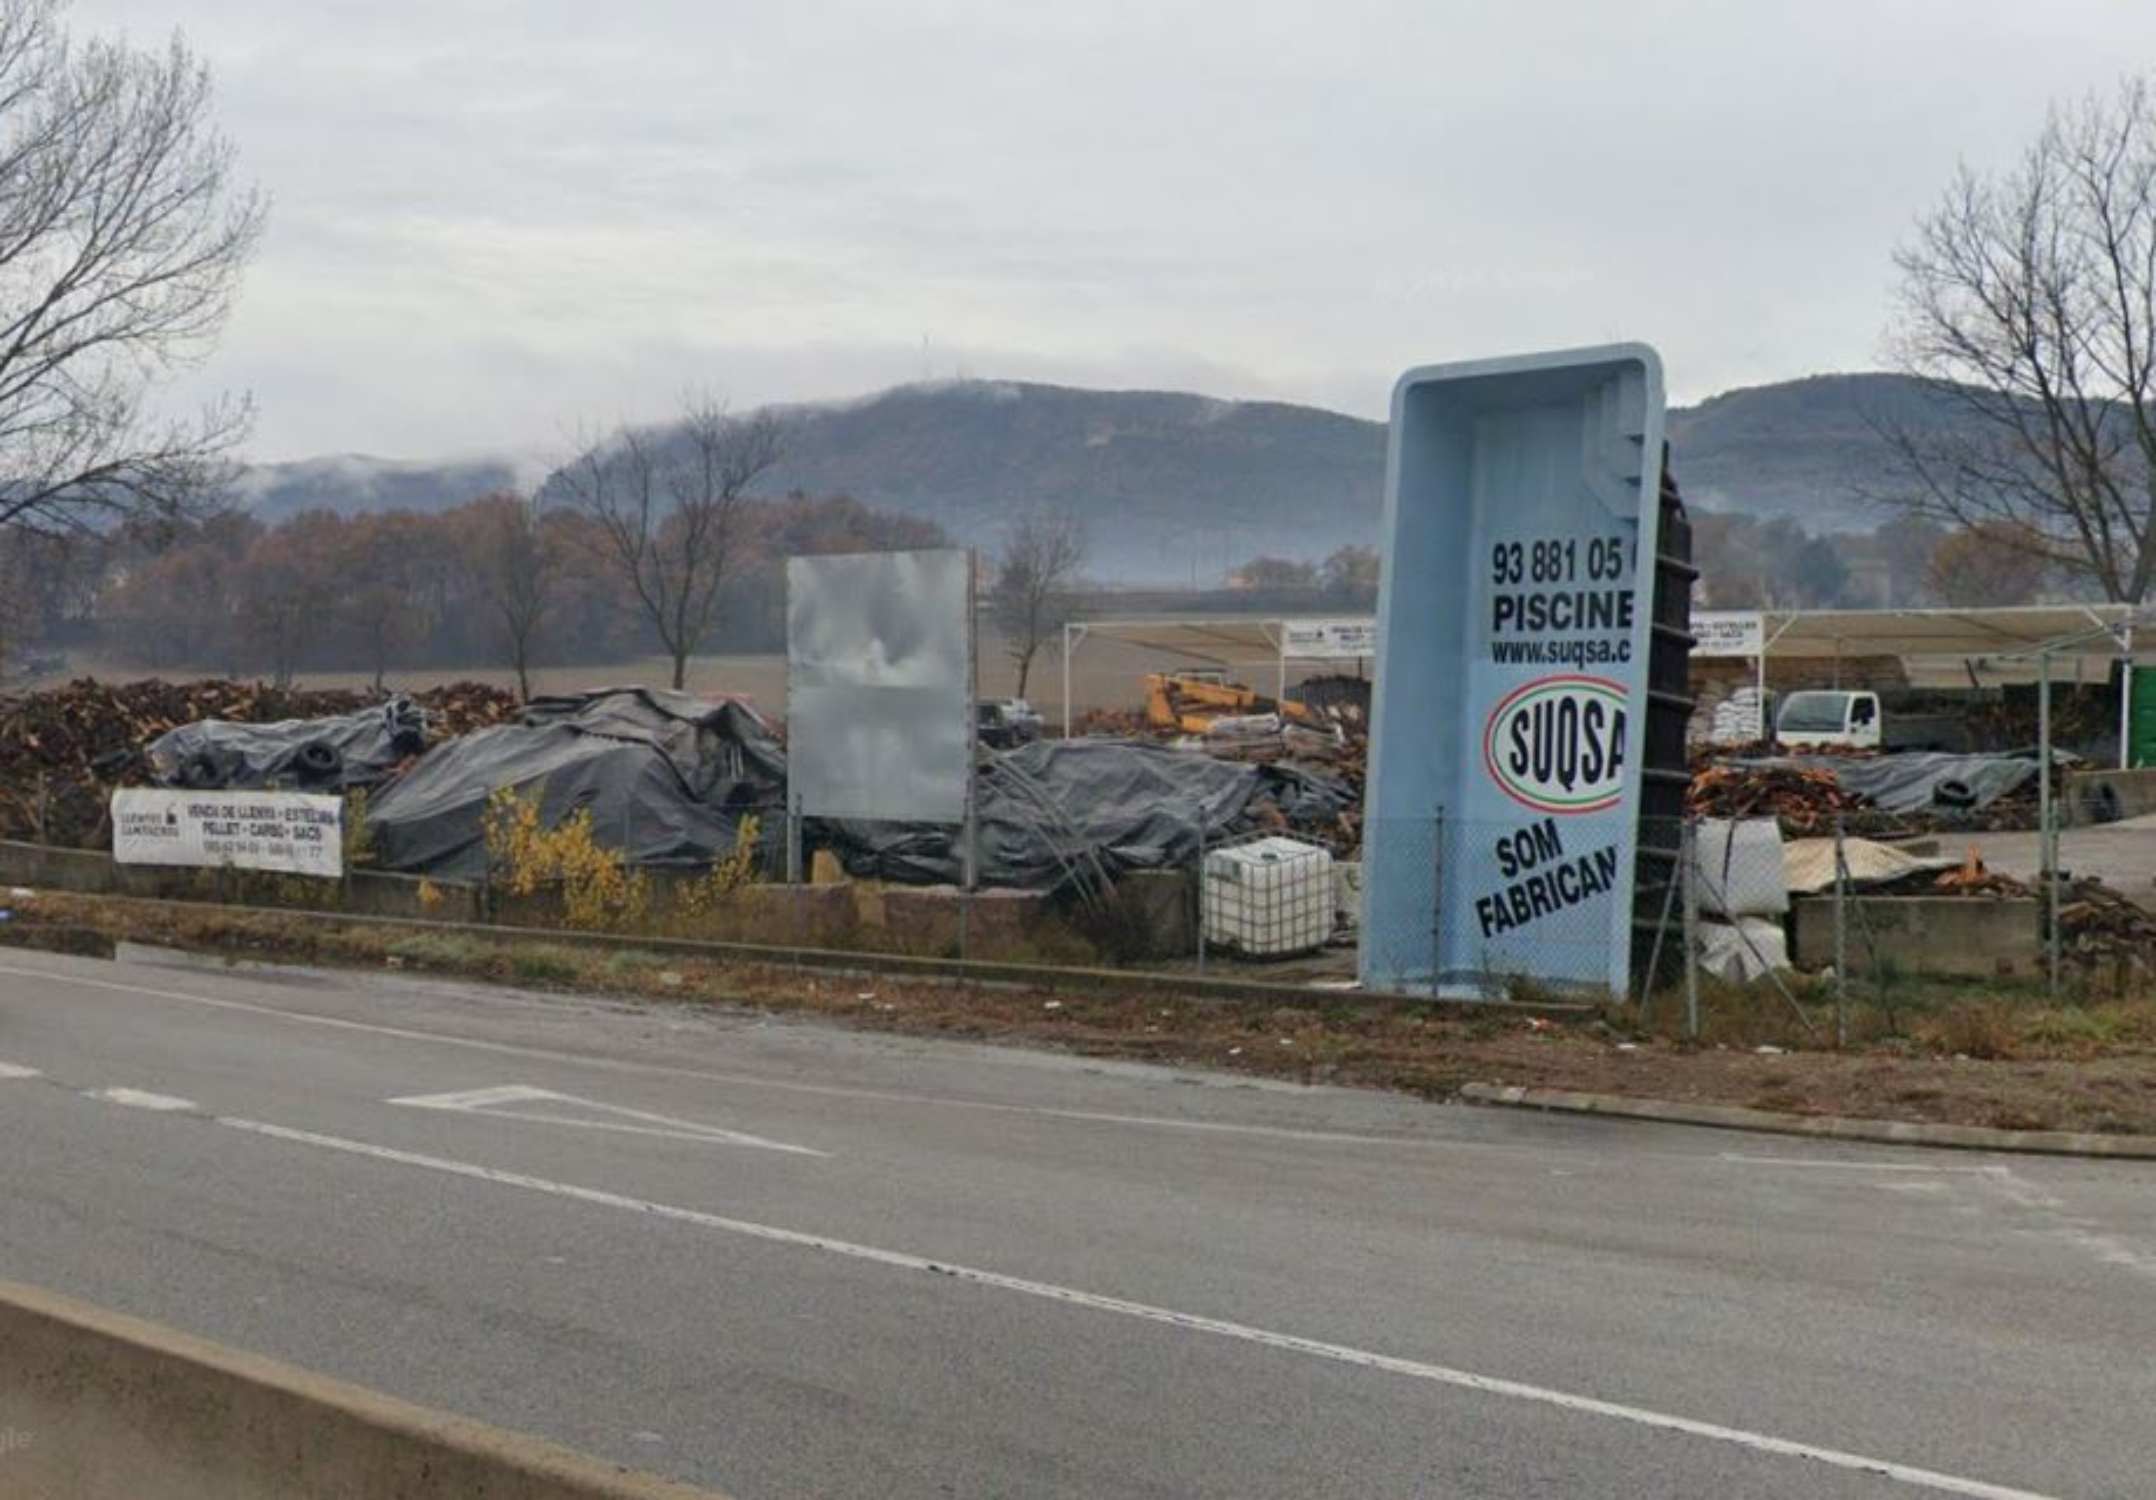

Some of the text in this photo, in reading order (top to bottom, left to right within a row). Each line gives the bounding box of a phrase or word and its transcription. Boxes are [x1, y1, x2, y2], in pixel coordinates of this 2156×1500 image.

[1492, 542, 1524, 585] 93
[1531, 539, 1576, 583] 881
[1588, 537, 1623, 581] 05
[1492, 590, 1636, 632] PISCINE
[1492, 639, 1631, 669] www.suqsa.c
[1509, 696, 1626, 793] SUQSA
[203, 822, 240, 835] PELLET
[1496, 818, 1563, 878] SOM
[1475, 845, 1618, 938] FABRICAN
